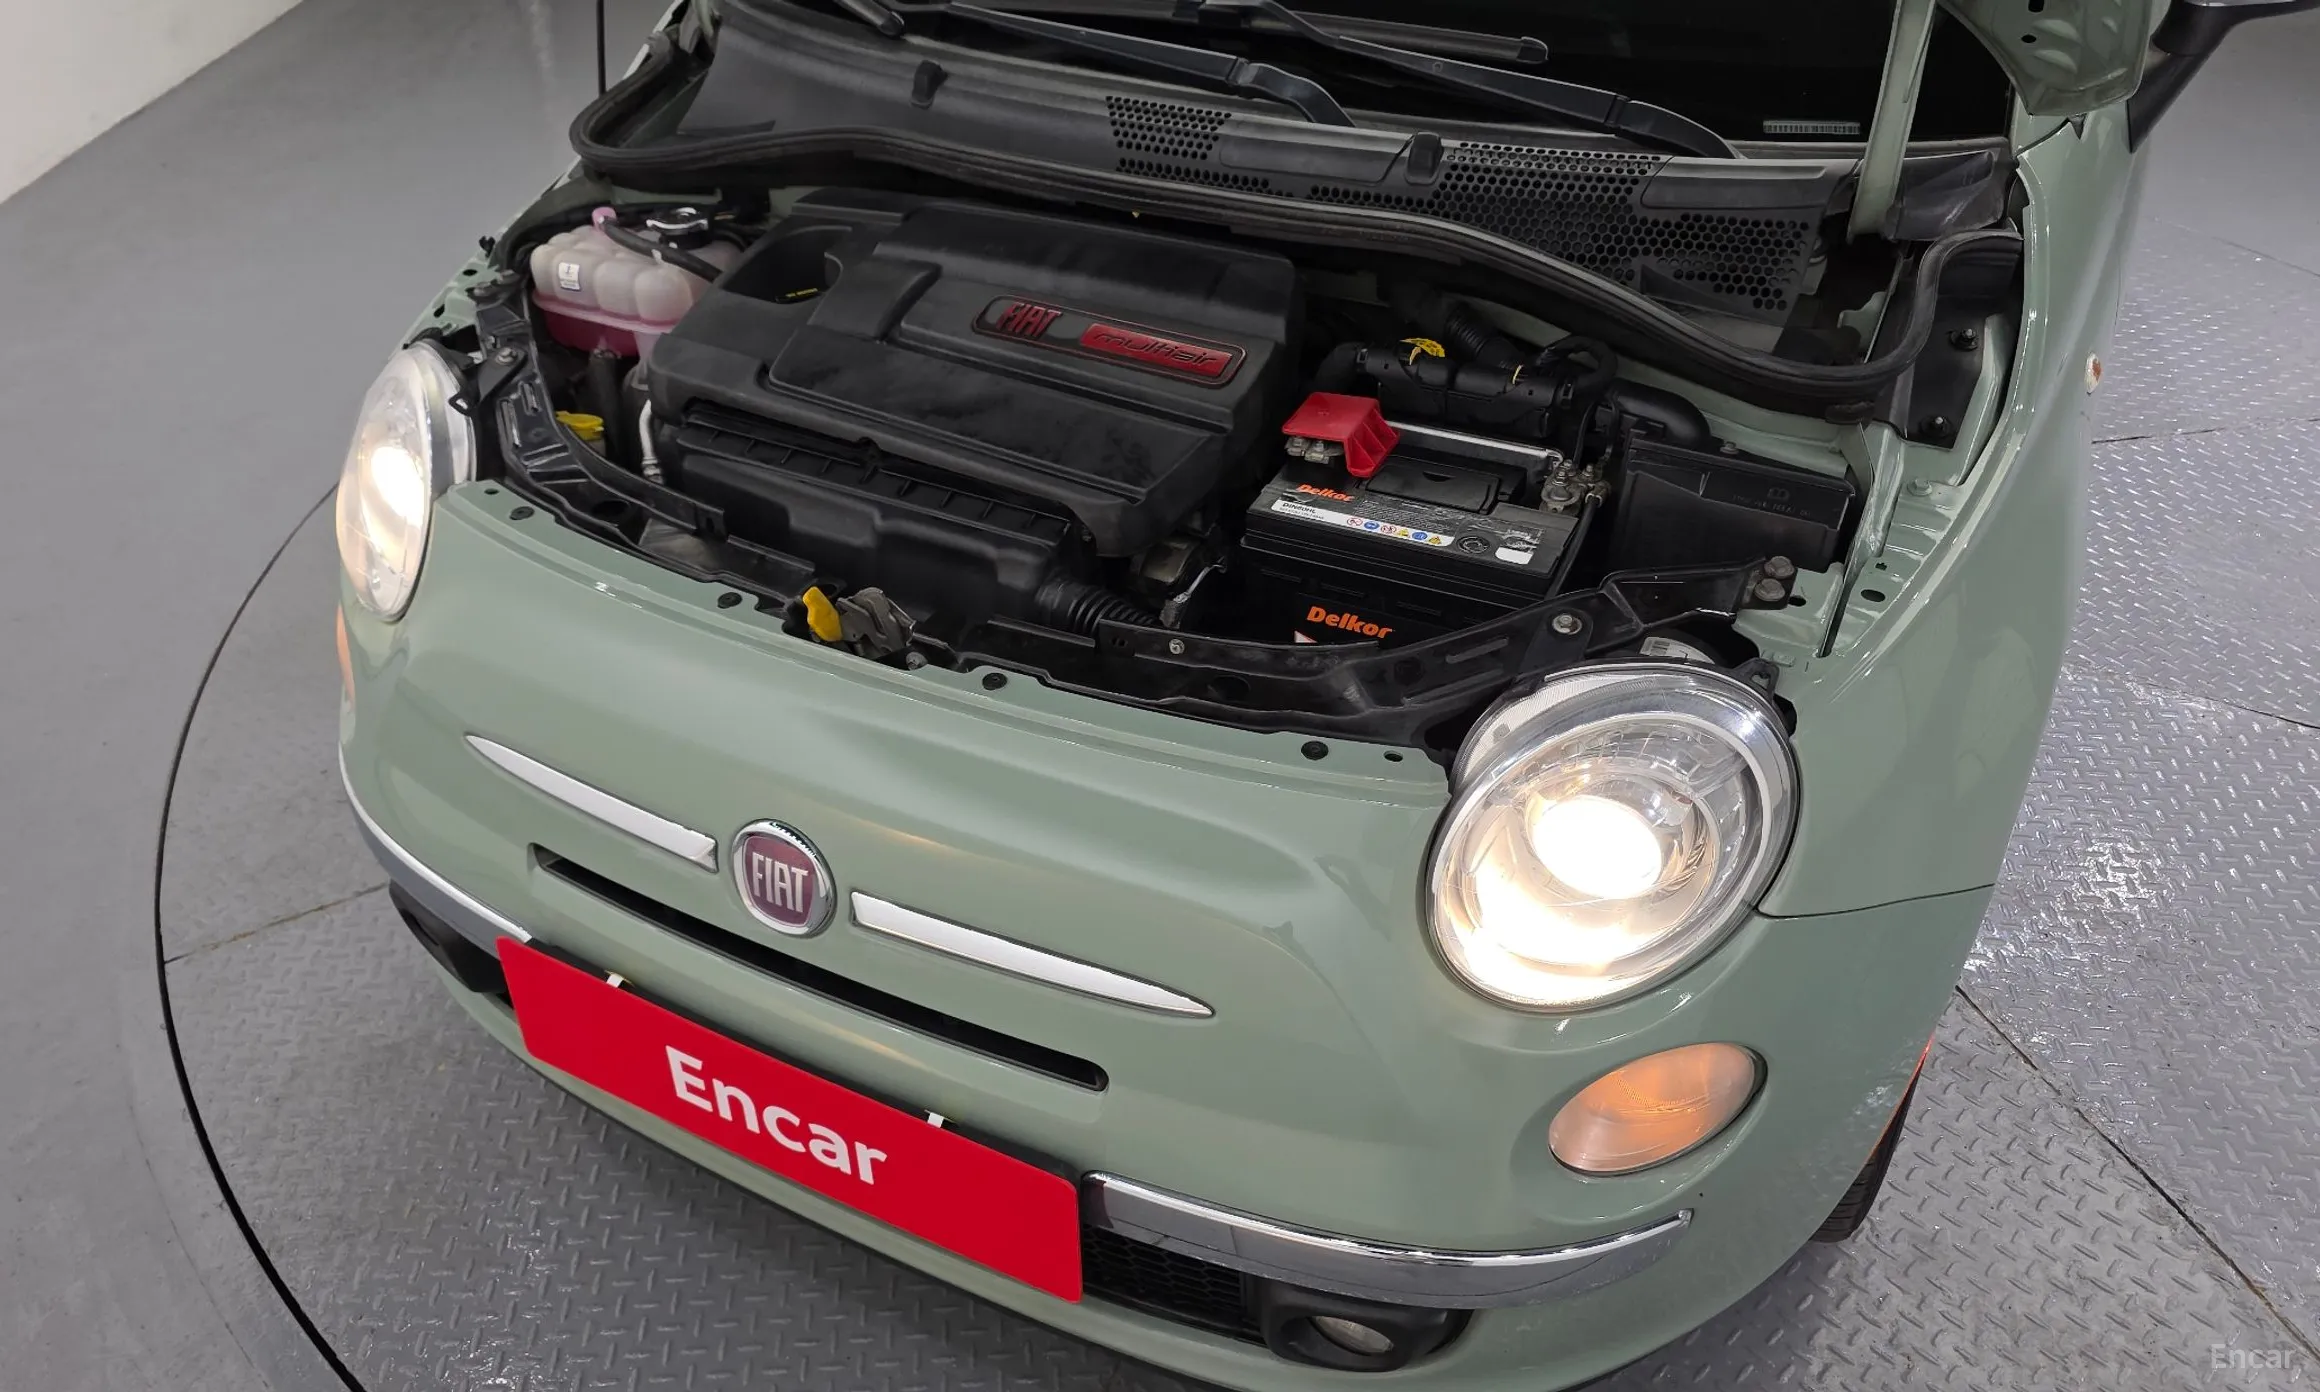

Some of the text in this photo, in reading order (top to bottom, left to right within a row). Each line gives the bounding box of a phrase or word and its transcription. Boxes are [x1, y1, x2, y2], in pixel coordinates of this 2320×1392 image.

[997, 301, 1218, 365] FIAT multiair
[1306, 606, 1393, 638] Delkor
[751, 852, 809, 912] FIAT
[665, 1044, 888, 1185] Encar
